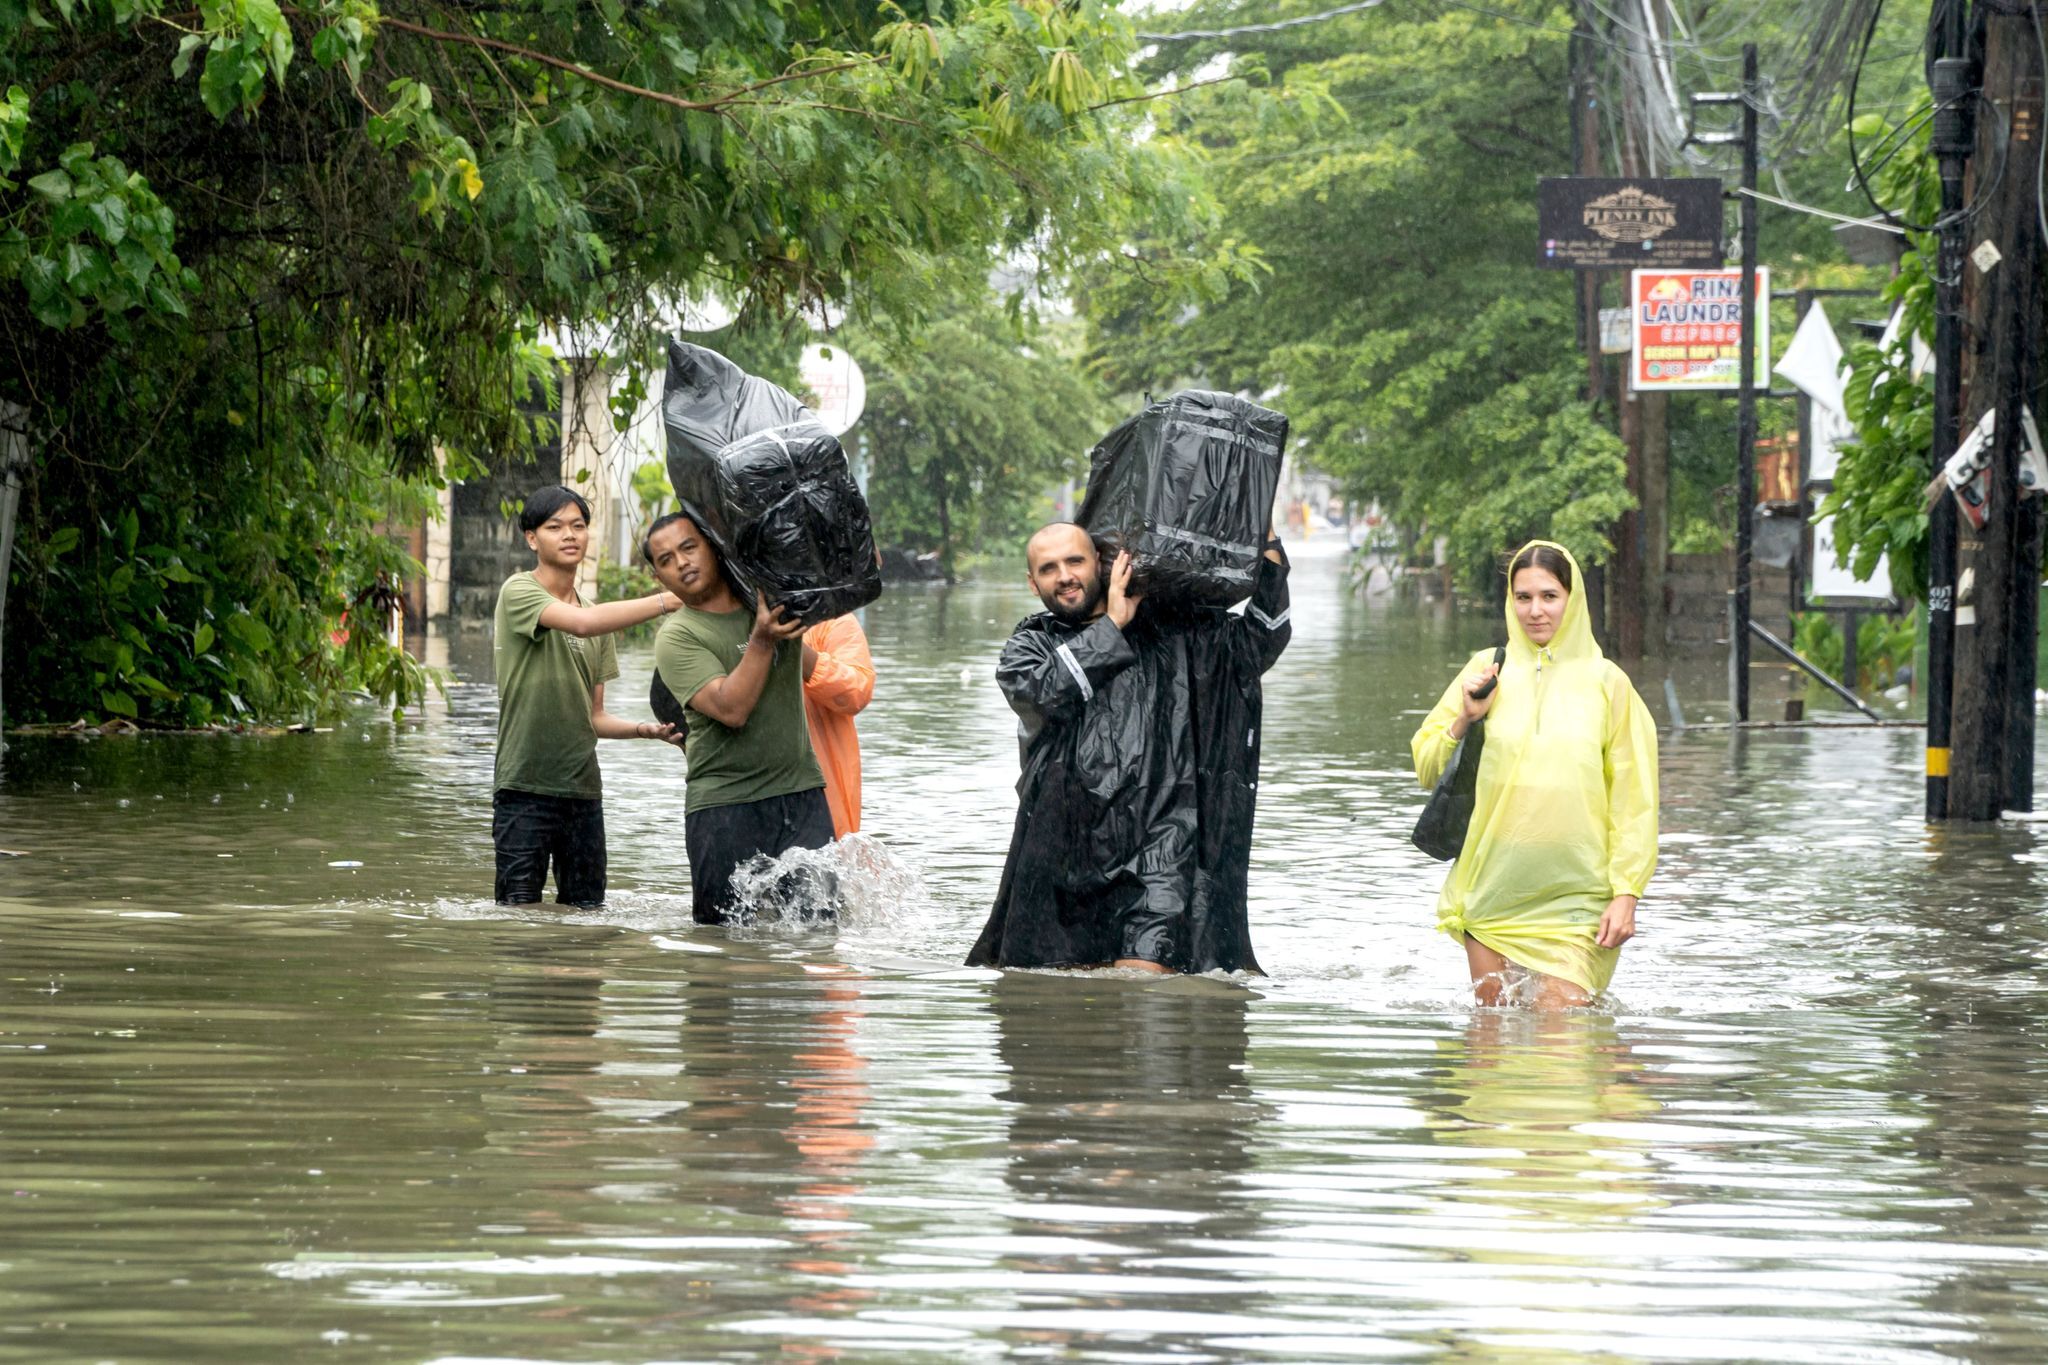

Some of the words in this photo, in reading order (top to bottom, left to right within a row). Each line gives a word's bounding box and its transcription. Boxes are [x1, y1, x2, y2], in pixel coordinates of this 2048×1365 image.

[1648, 208, 1678, 227] INK
[1643, 303, 1742, 323] LAUNDR
[1661, 326, 1740, 343] EXPRES
